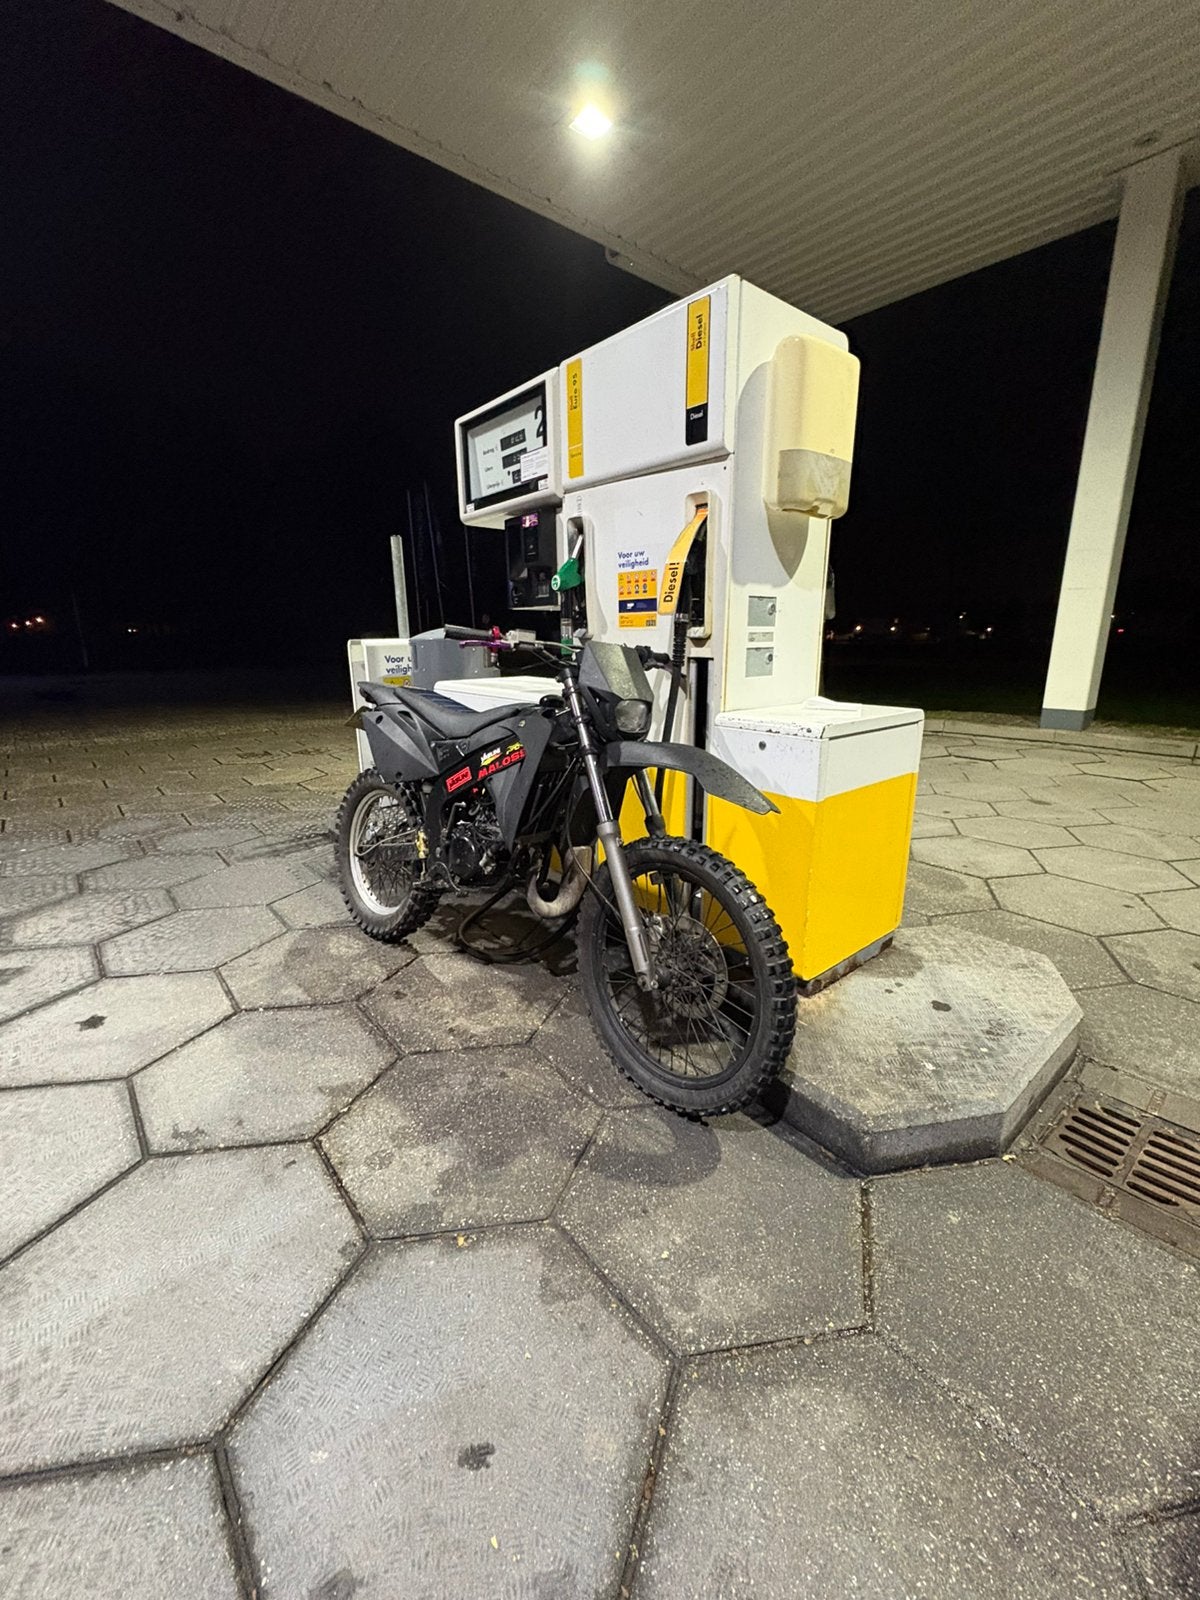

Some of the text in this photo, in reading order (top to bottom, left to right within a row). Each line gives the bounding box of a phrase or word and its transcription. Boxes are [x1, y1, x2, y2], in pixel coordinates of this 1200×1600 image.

[696, 313, 704, 350] Diesel
[572, 373, 578, 386] 95
[690, 409, 704, 421] Diesel
[534, 405, 545, 438] 2
[617, 550, 646, 559] Voor uw
[617, 557, 650, 569] veiligheid
[663, 561, 680, 603] Diesel!
[384, 655, 405, 663] Voor
